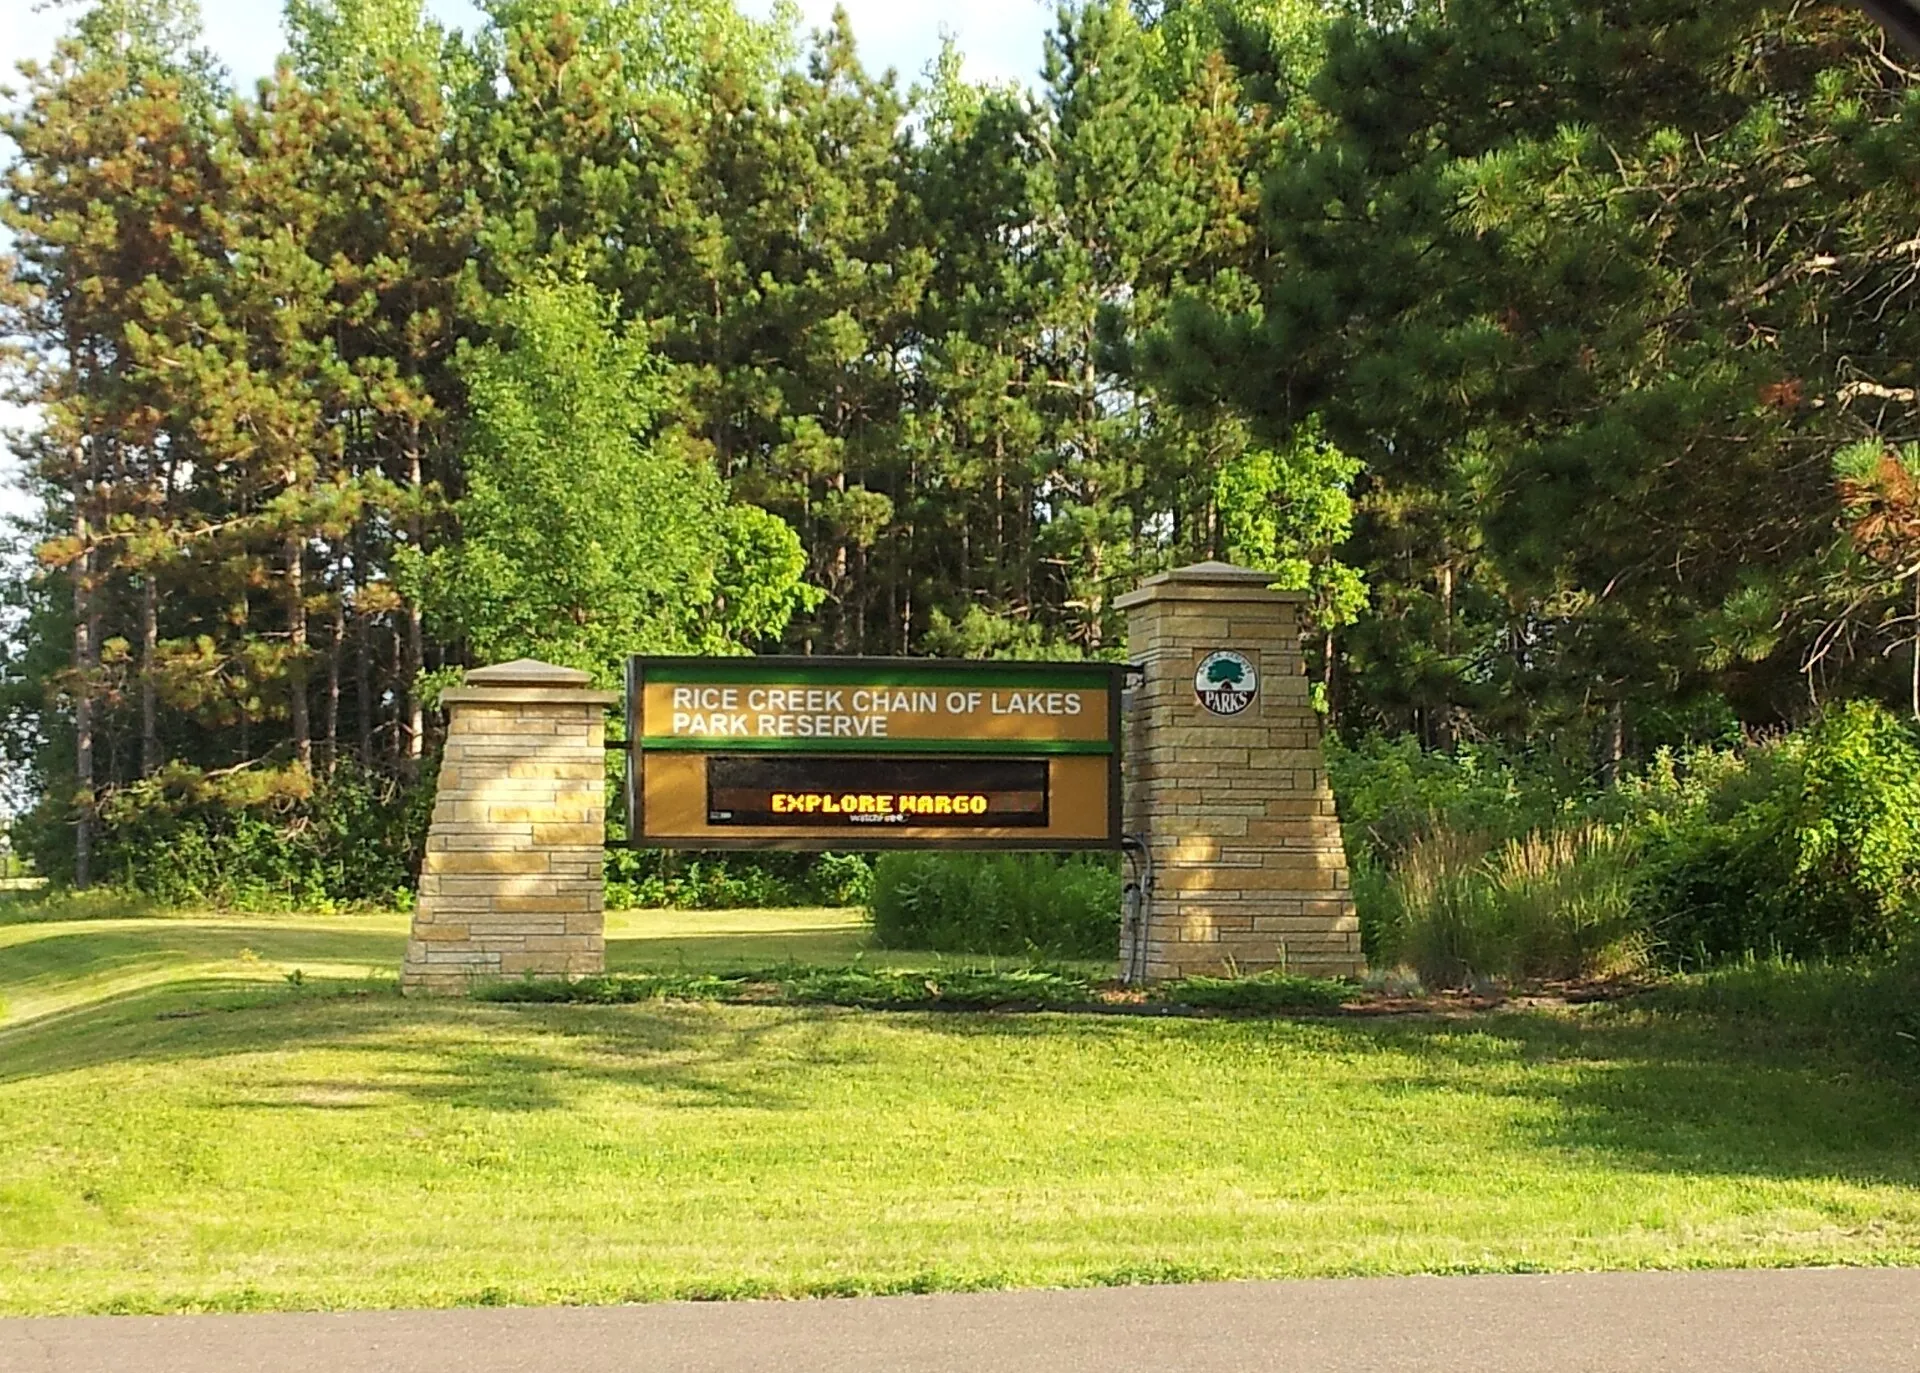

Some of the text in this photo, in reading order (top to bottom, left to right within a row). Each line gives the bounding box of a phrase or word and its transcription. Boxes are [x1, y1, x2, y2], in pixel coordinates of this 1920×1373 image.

[673, 688, 1081, 715] RICE CREEK CHAIN OF LAKES
[1205, 691, 1247, 713] PARKS
[673, 712, 888, 737] PARK RESERVE
[771, 794, 893, 813] EXPLORE
